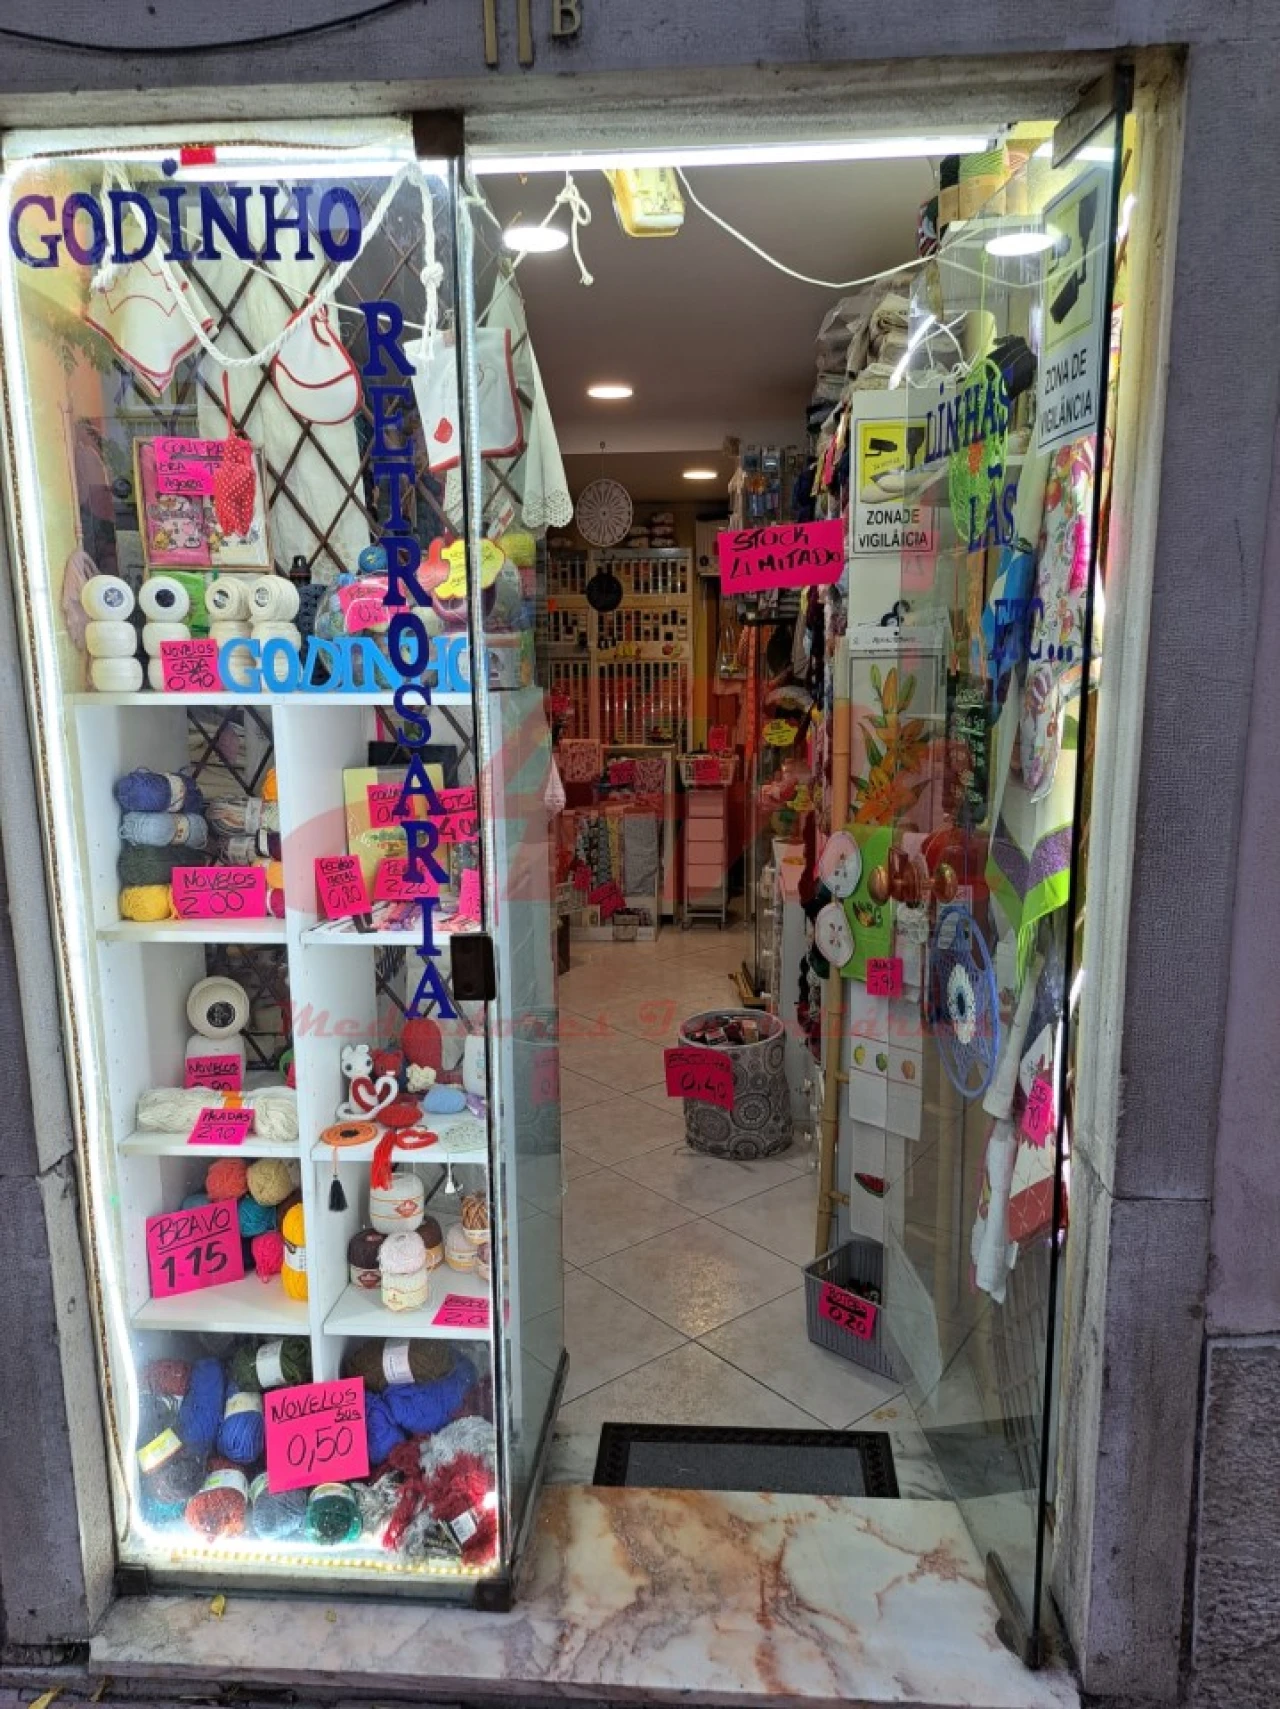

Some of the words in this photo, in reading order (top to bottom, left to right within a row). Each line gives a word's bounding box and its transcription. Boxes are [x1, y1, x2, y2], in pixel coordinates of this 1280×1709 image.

[1071, 348, 1087, 380] DE
[866, 510, 902, 526] ZONA
[361, 299, 456, 1019] RETROSARIA
[183, 870, 257, 892] NOVELOS
[270, 1387, 358, 1424] NOVELOS
[286, 1425, 354, 1473] 0,50
